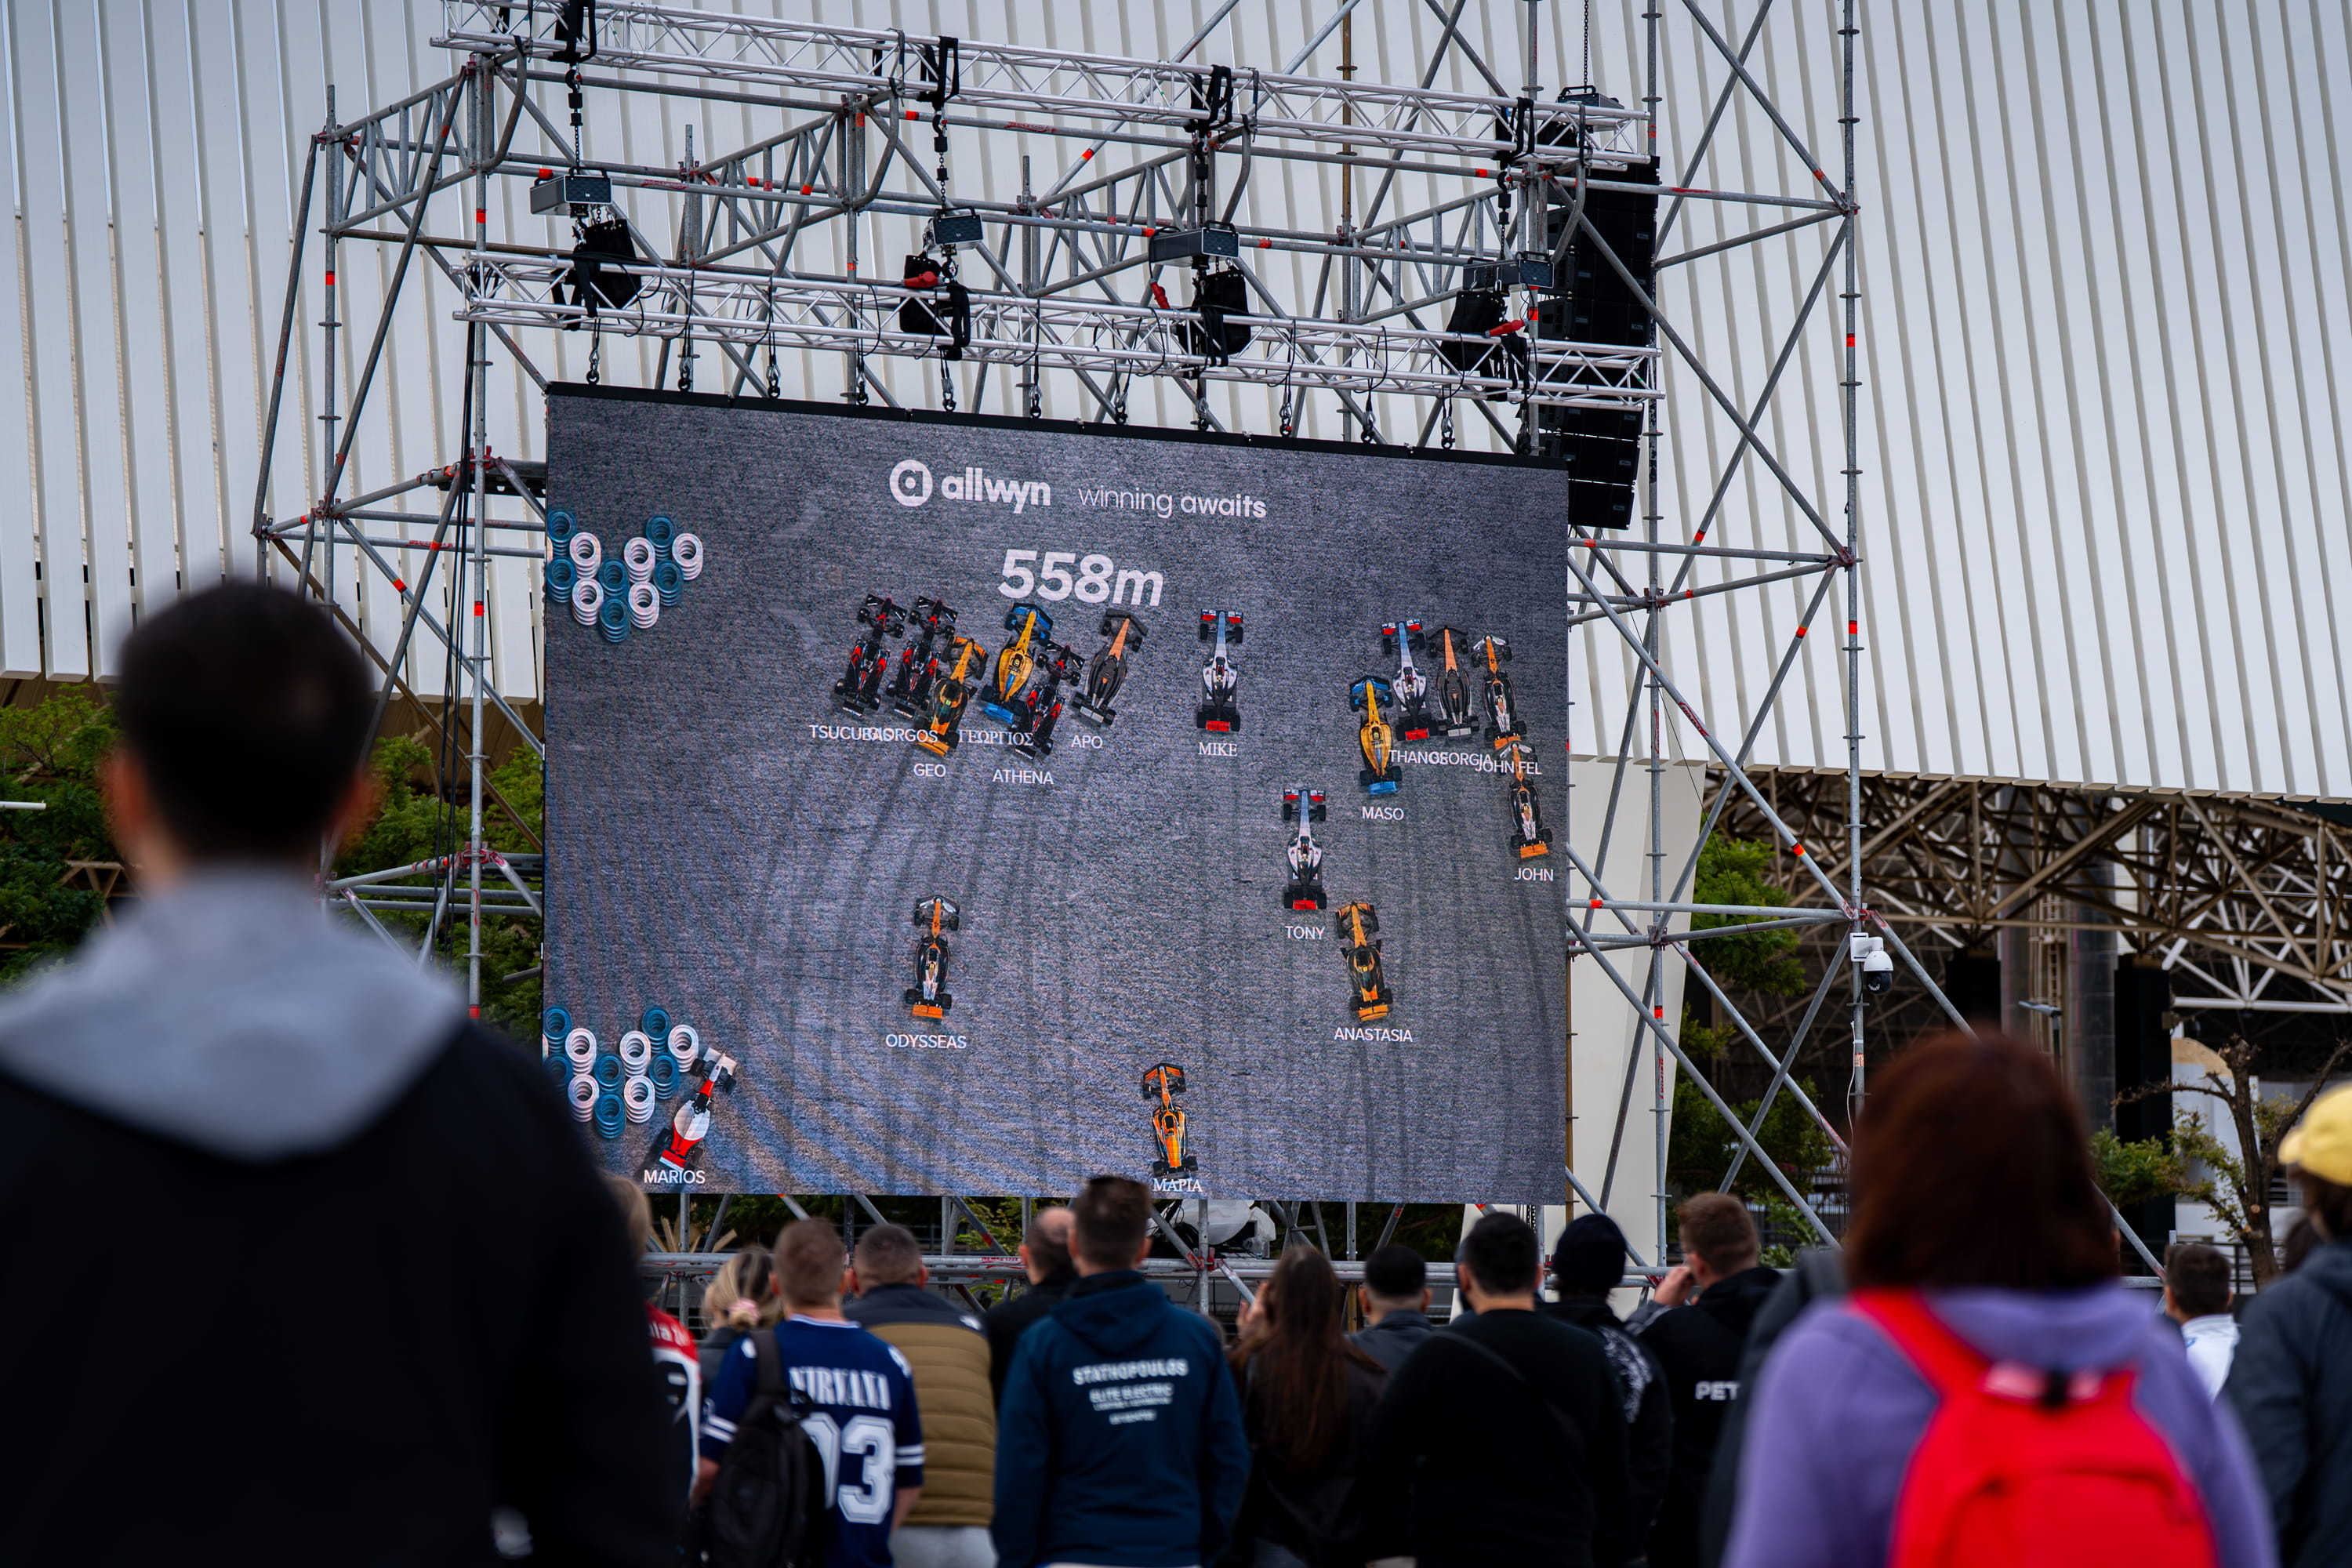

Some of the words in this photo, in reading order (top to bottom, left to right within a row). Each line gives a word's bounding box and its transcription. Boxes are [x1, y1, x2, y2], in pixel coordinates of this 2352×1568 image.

[942, 467, 1051, 514] allwyn
[1078, 485, 1173, 519] winning
[1180, 493, 1267, 518] awaits
[998, 549, 1164, 607] 558m
[1071, 735, 1103, 750] APO
[1197, 742, 1238, 757] MIKE
[913, 763, 946, 778] GEO
[1518, 760, 1543, 775] FEL
[992, 769, 1054, 785] ATHENA
[1361, 806, 1404, 821] MASO
[1514, 867, 1554, 882] JOHN
[1284, 925, 1326, 940] TONY
[885, 1033, 967, 1049] ODYSSEAS
[1334, 1027, 1414, 1043] ANASTASIA
[644, 1169, 706, 1185] MARIOS
[1072, 1357, 1189, 1386] STATHOPOULOS
[789, 1366, 892, 1410] NIRVANA
